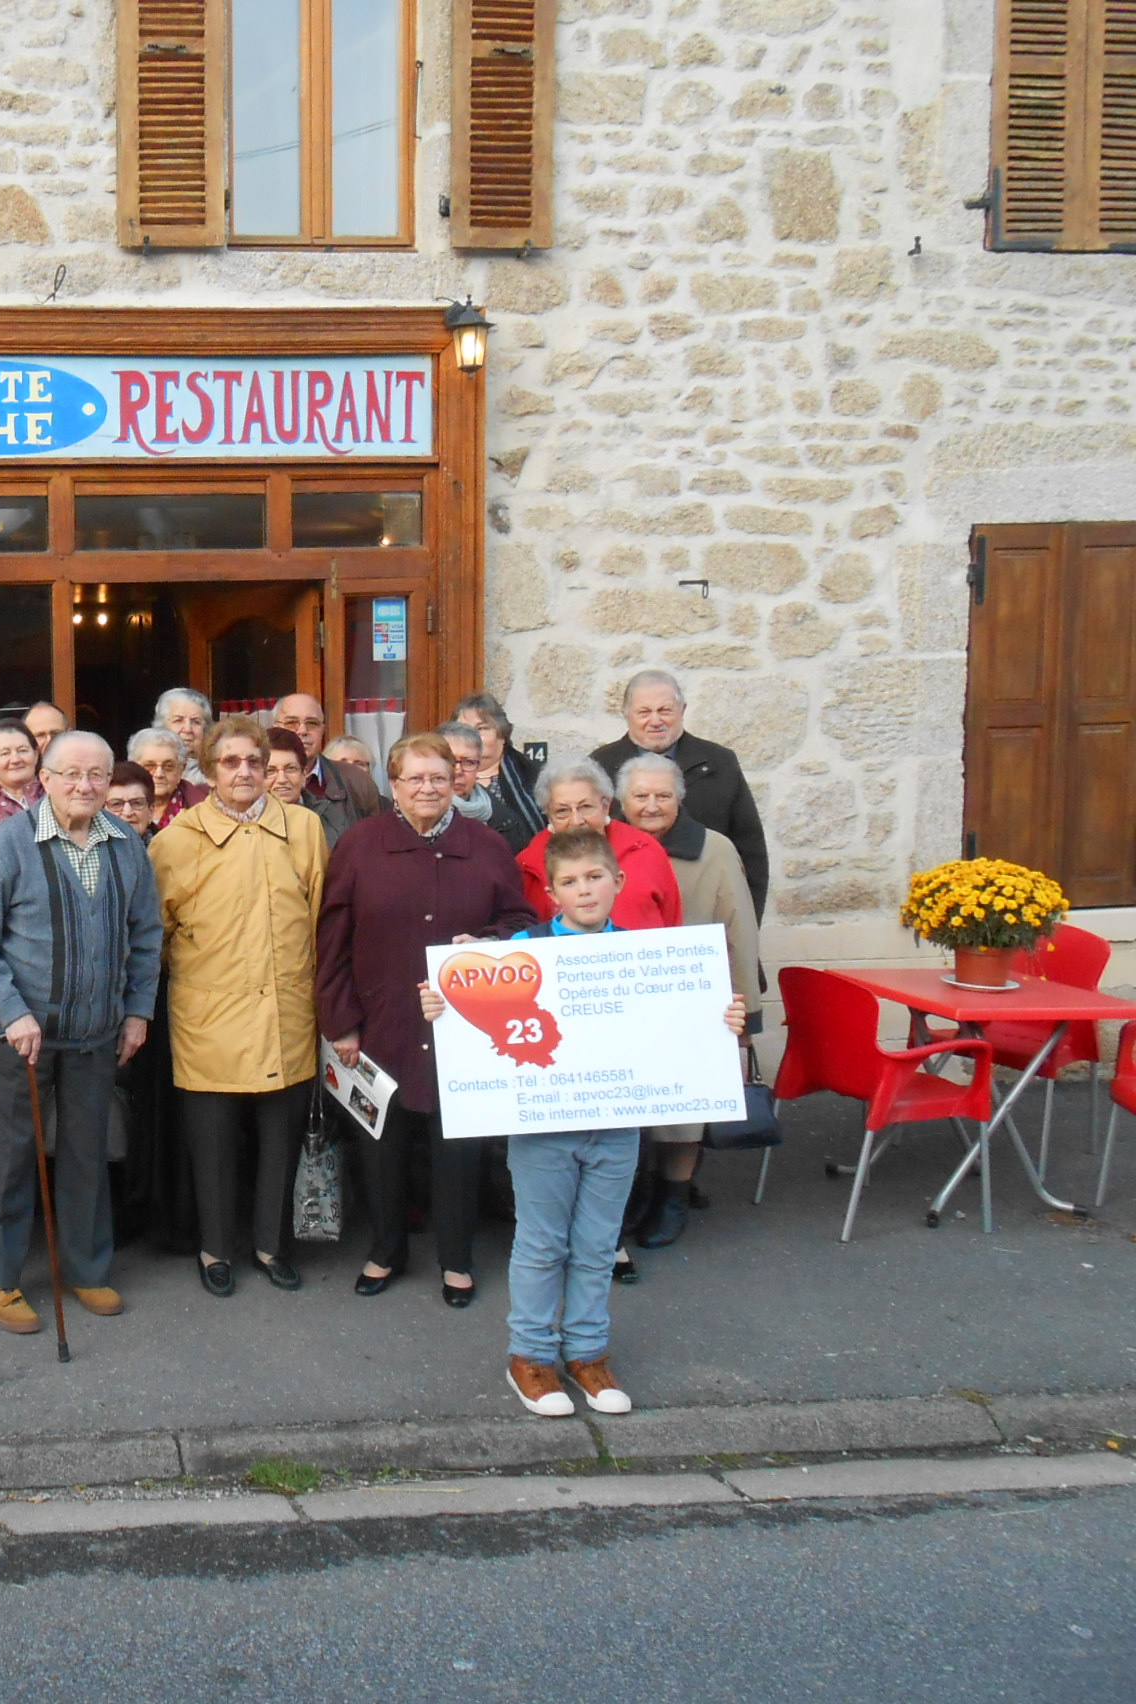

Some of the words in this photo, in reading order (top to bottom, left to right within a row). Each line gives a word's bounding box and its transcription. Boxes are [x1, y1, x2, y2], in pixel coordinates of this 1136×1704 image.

[111, 369, 425, 456] RESTAURANT
[526, 748, 545, 762] 14
[556, 950, 634, 966] Association
[637, 949, 662, 960] des
[447, 963, 538, 989] APVOC
[557, 968, 614, 983] Porteurs
[619, 967, 636, 979] de
[639, 964, 686, 977] Valves
[690, 962, 704, 973] et
[613, 984, 630, 996] du
[677, 979, 695, 991] de
[699, 978, 712, 990] la
[561, 1001, 624, 1017] CREUSE
[506, 1017, 544, 1044] 23
[448, 1078, 508, 1093] Contacts
[549, 1069, 635, 1086] 0641465581
[517, 1091, 561, 1105] E-mail
[572, 1083, 684, 1103] apvoc23@live.fr
[519, 1109, 545, 1122] Site
[549, 1106, 601, 1120] internet
[612, 1097, 738, 1117] www.apvoc23.org
